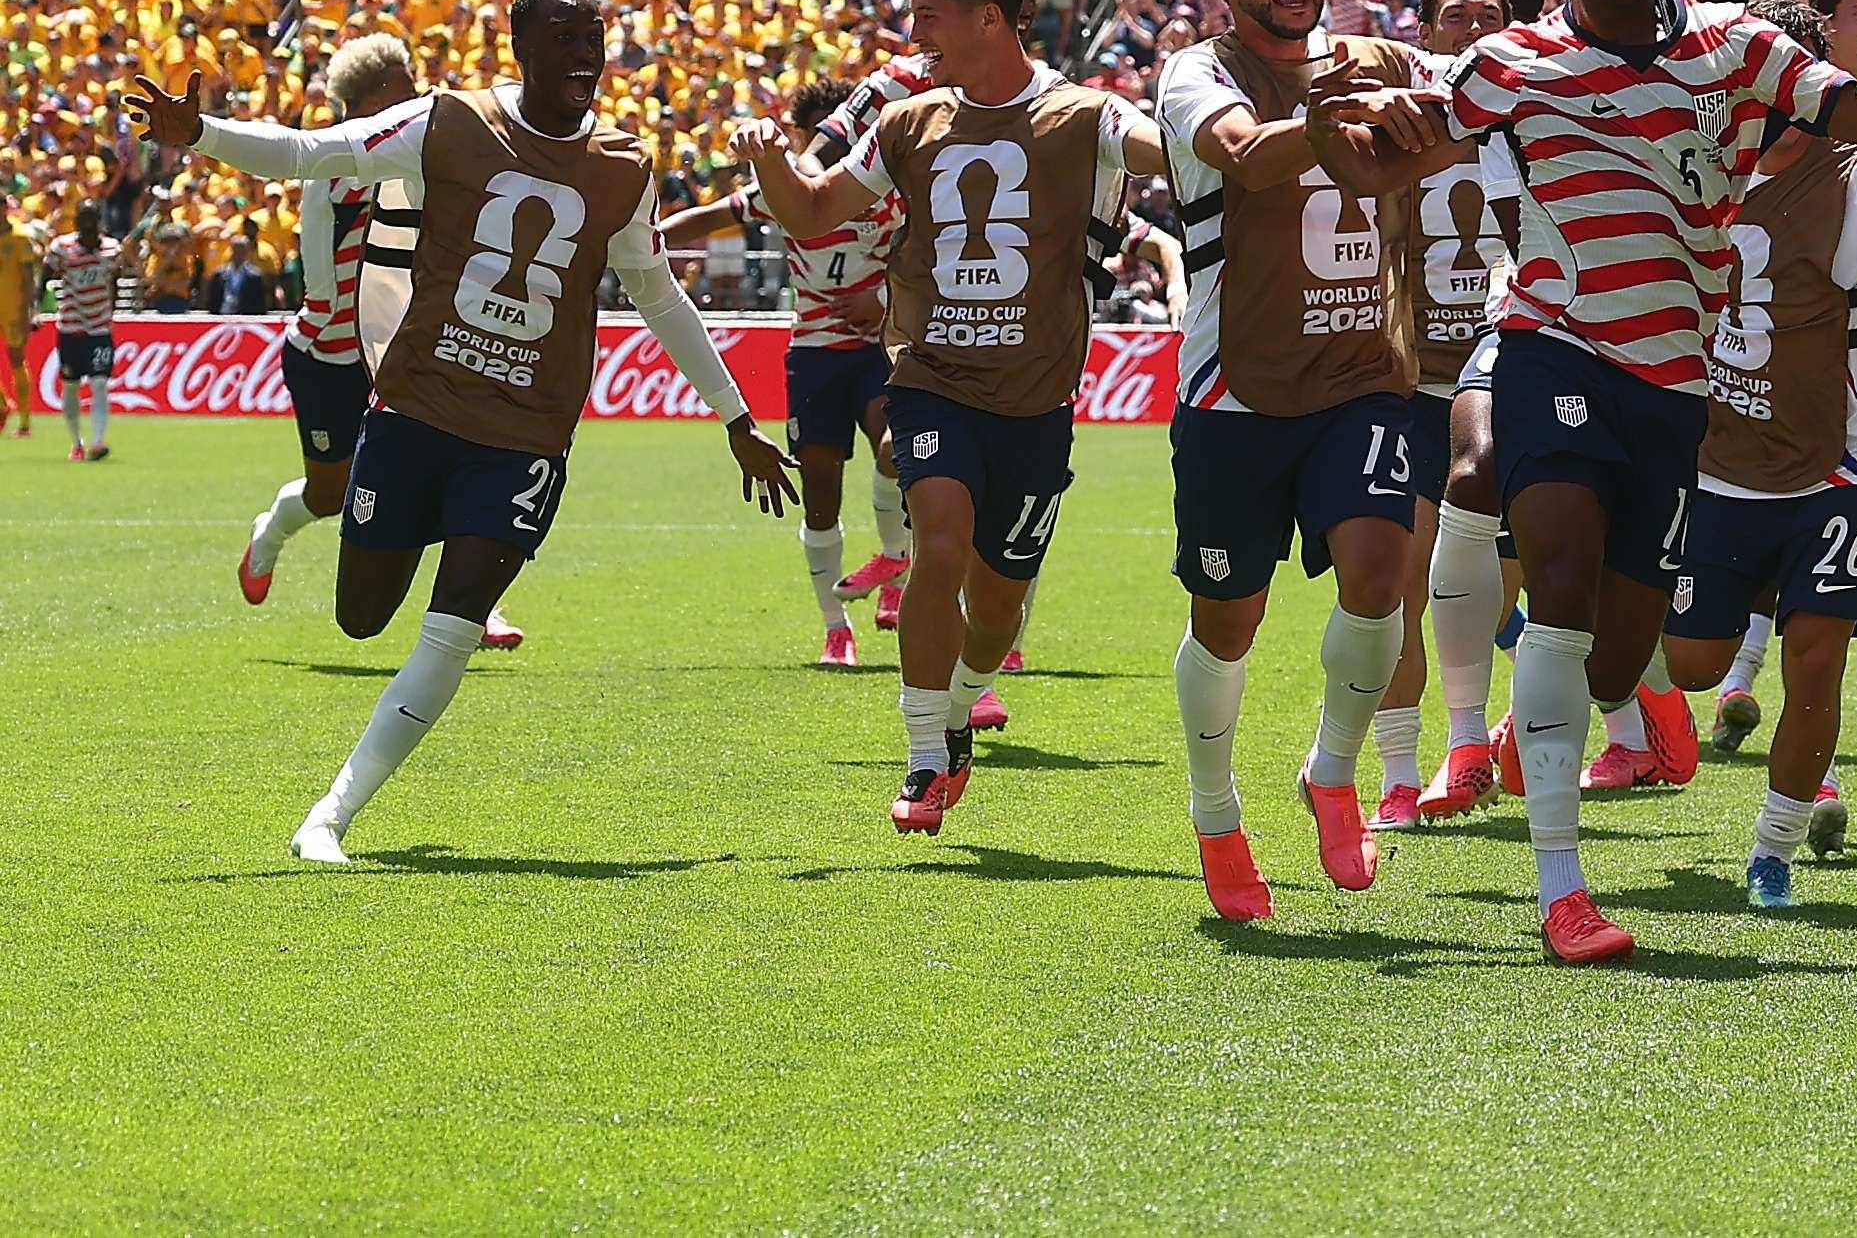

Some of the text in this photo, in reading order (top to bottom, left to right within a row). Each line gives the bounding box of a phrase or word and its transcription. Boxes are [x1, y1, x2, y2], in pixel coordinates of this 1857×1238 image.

[1696, 92, 1724, 113] USA
[1335, 241, 1374, 262] FIFA
[827, 252, 846, 285] 4
[955, 268, 1001, 285] FIFA
[1303, 286, 1370, 305] WORLD
[481, 299, 527, 327] FIFA
[932, 305, 1027, 321] WORLD CUP
[1424, 309, 1484, 319] WORLD
[442, 323, 541, 364] WORLD CUP
[925, 322, 1024, 346] 2026
[1722, 331, 1747, 354] FIFA
[434, 339, 534, 387] 2026
[1710, 365, 1772, 394] ORLD CUP
[1557, 397, 1583, 409] USA
[1708, 380, 1772, 420] 026
[915, 433, 936, 444] USA
[1363, 425, 1410, 482] 15
[357, 488, 374, 504] USA
[1006, 493, 1061, 545] 14
[1202, 549, 1225, 562] USA
